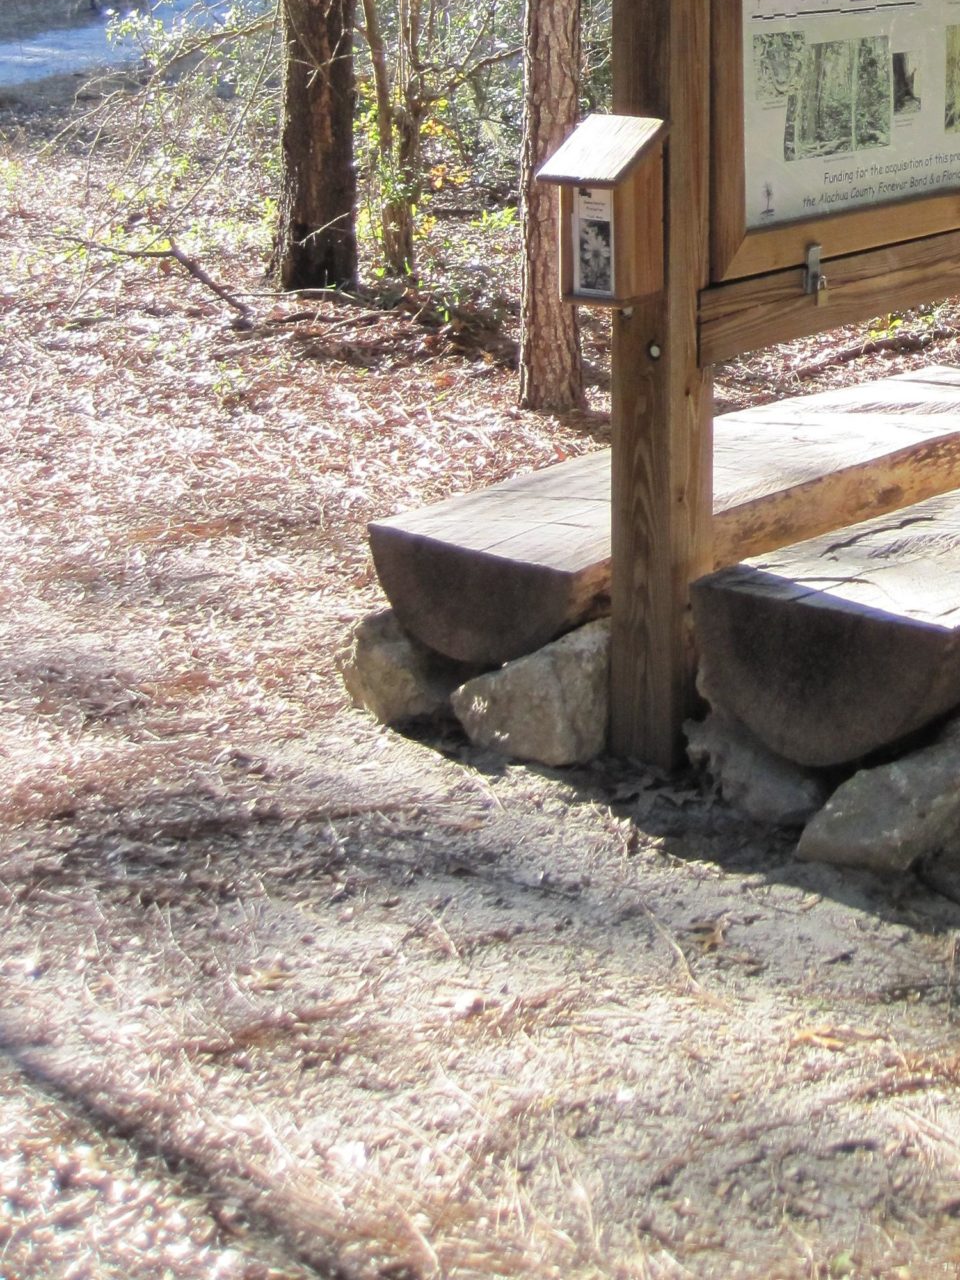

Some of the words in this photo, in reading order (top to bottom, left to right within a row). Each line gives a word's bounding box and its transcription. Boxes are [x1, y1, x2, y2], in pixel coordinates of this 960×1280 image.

[823, 170, 854, 184] Funding
[855, 167, 868, 179] for
[870, 164, 882, 176] the
[884, 159, 923, 175] acquisition
[925, 156, 933, 167] of
[935, 153, 948, 163] this
[802, 195, 815, 208] the
[819, 190, 849, 203] Alachua
[850, 186, 875, 199] County
[878, 181, 908, 194] Forever
[909, 175, 927, 189] Bond
[929, 173, 935, 185] &
